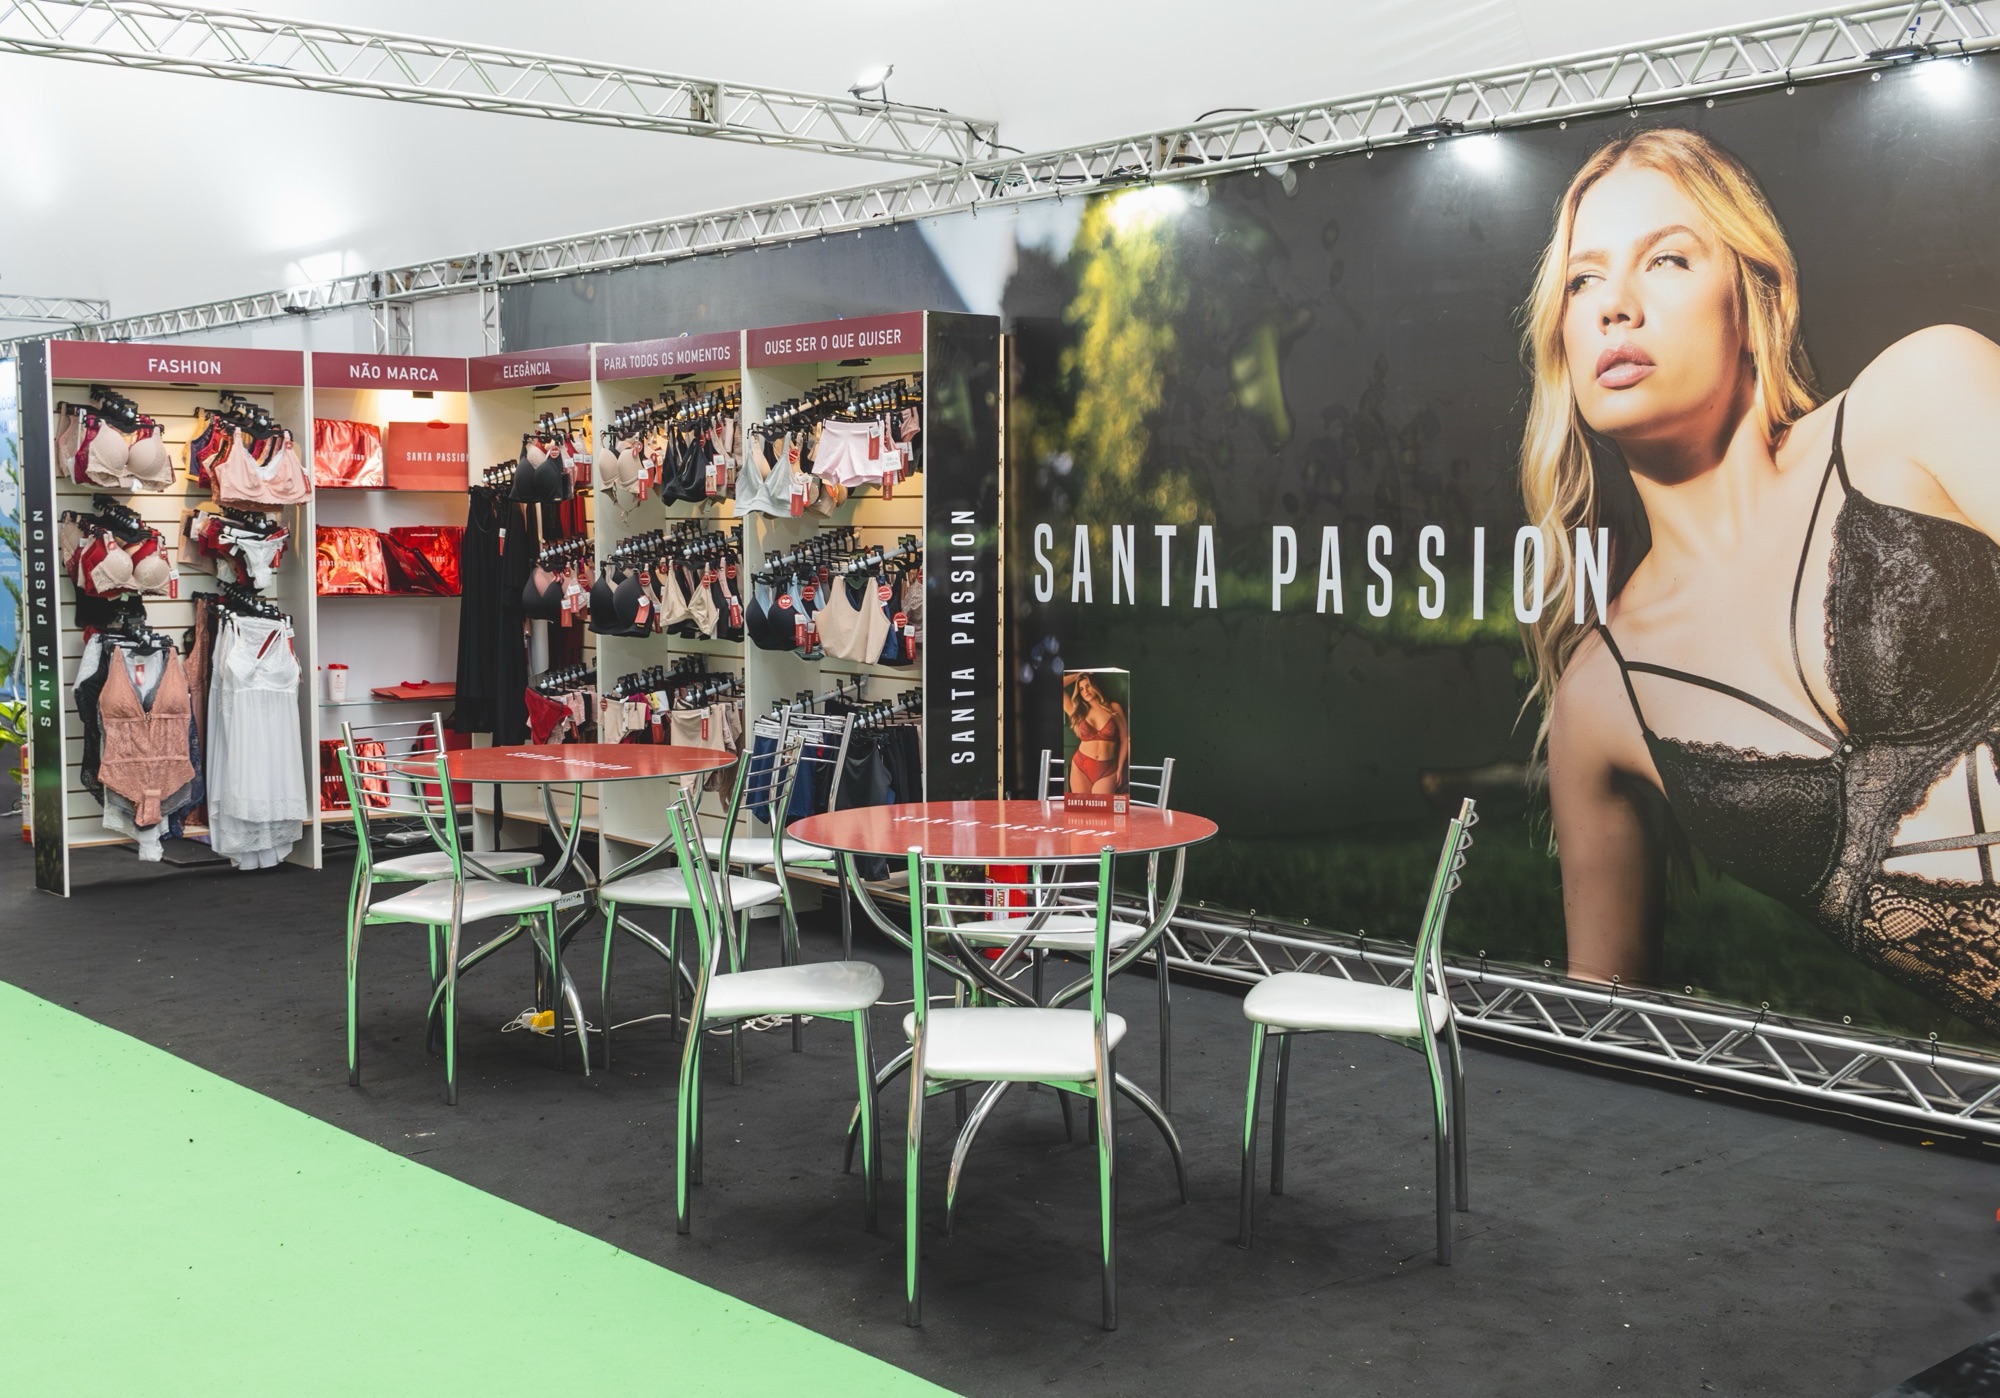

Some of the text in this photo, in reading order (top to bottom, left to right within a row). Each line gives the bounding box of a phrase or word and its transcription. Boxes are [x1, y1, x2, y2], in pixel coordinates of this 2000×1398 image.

[765, 329, 901, 355] OUSE SER O QUE QUISER
[148, 358, 221, 375] FASHION
[604, 346, 731, 371] PARA TODOS OS MOMENTOS
[349, 362, 439, 381] NÃO MARCA
[503, 360, 551, 379] ELEGÂNCIA
[406, 451, 432, 462] SANTA
[1034, 522, 1609, 626] SANTA PASSION
[33, 510, 51, 727] SANTA PASSION
[951, 511, 975, 764] SANTA PASSION
[324, 775, 343, 783] SANTA
[1085, 799, 1107, 807] PASSION
[893, 815, 1117, 838] SANTA PASSION
